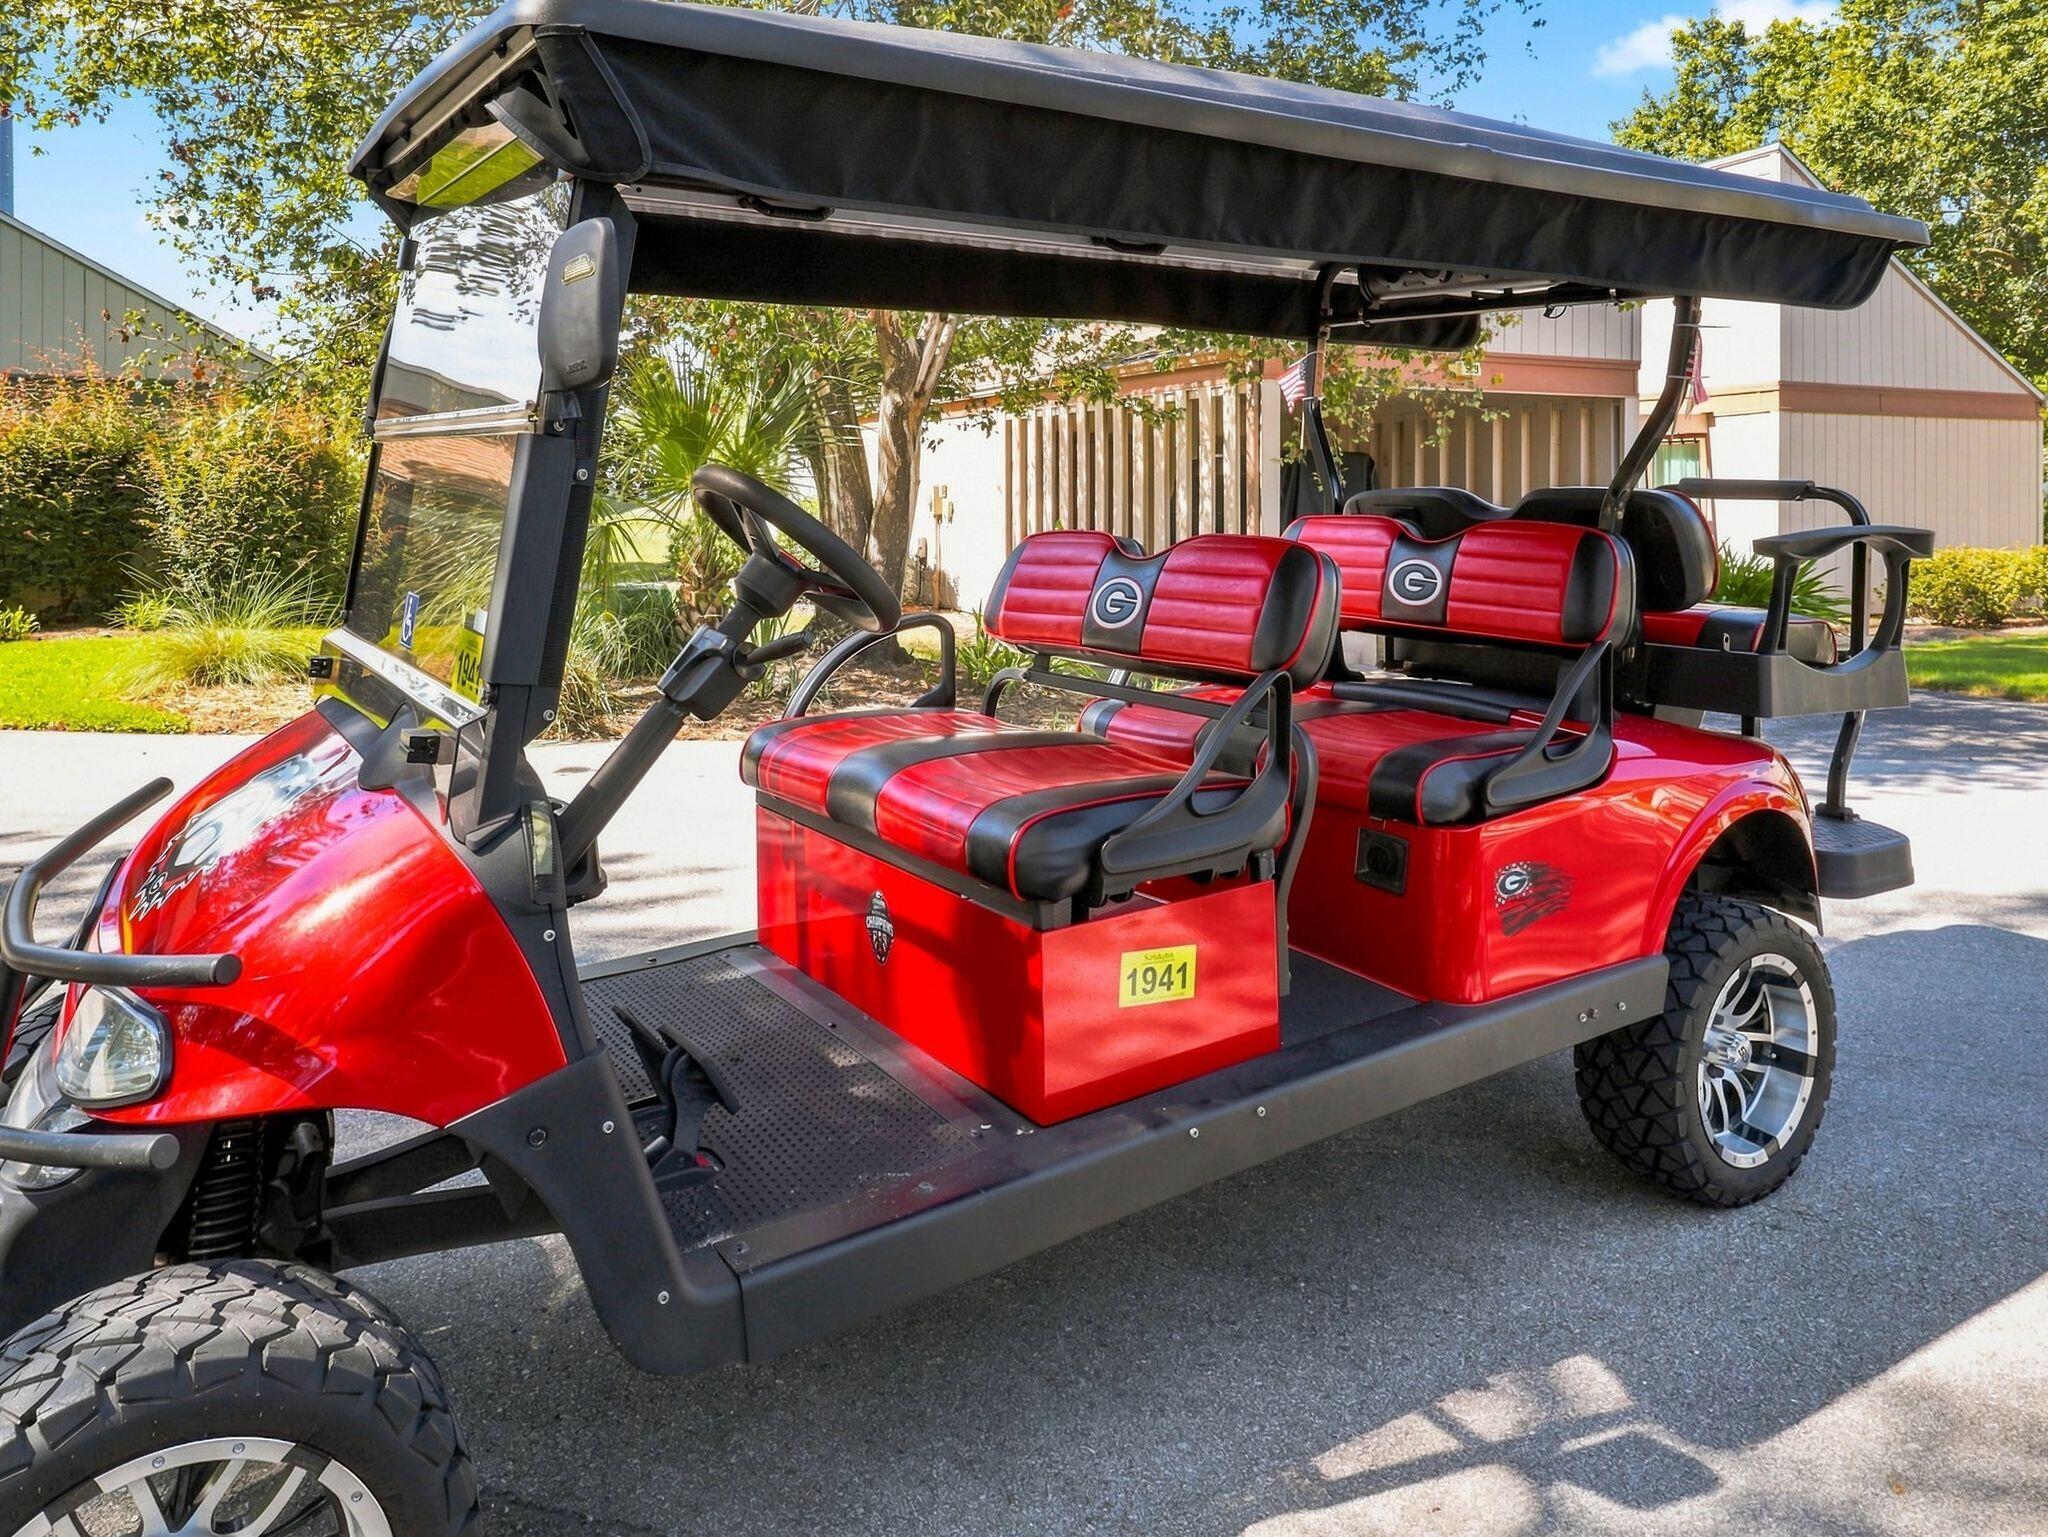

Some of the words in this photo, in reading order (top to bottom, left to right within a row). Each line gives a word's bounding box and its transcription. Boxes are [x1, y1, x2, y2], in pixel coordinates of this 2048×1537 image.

[1391, 561, 1440, 604] G
[1094, 579, 1140, 626] G
[1499, 870, 1527, 896] G
[1126, 961, 1188, 997] 1941
